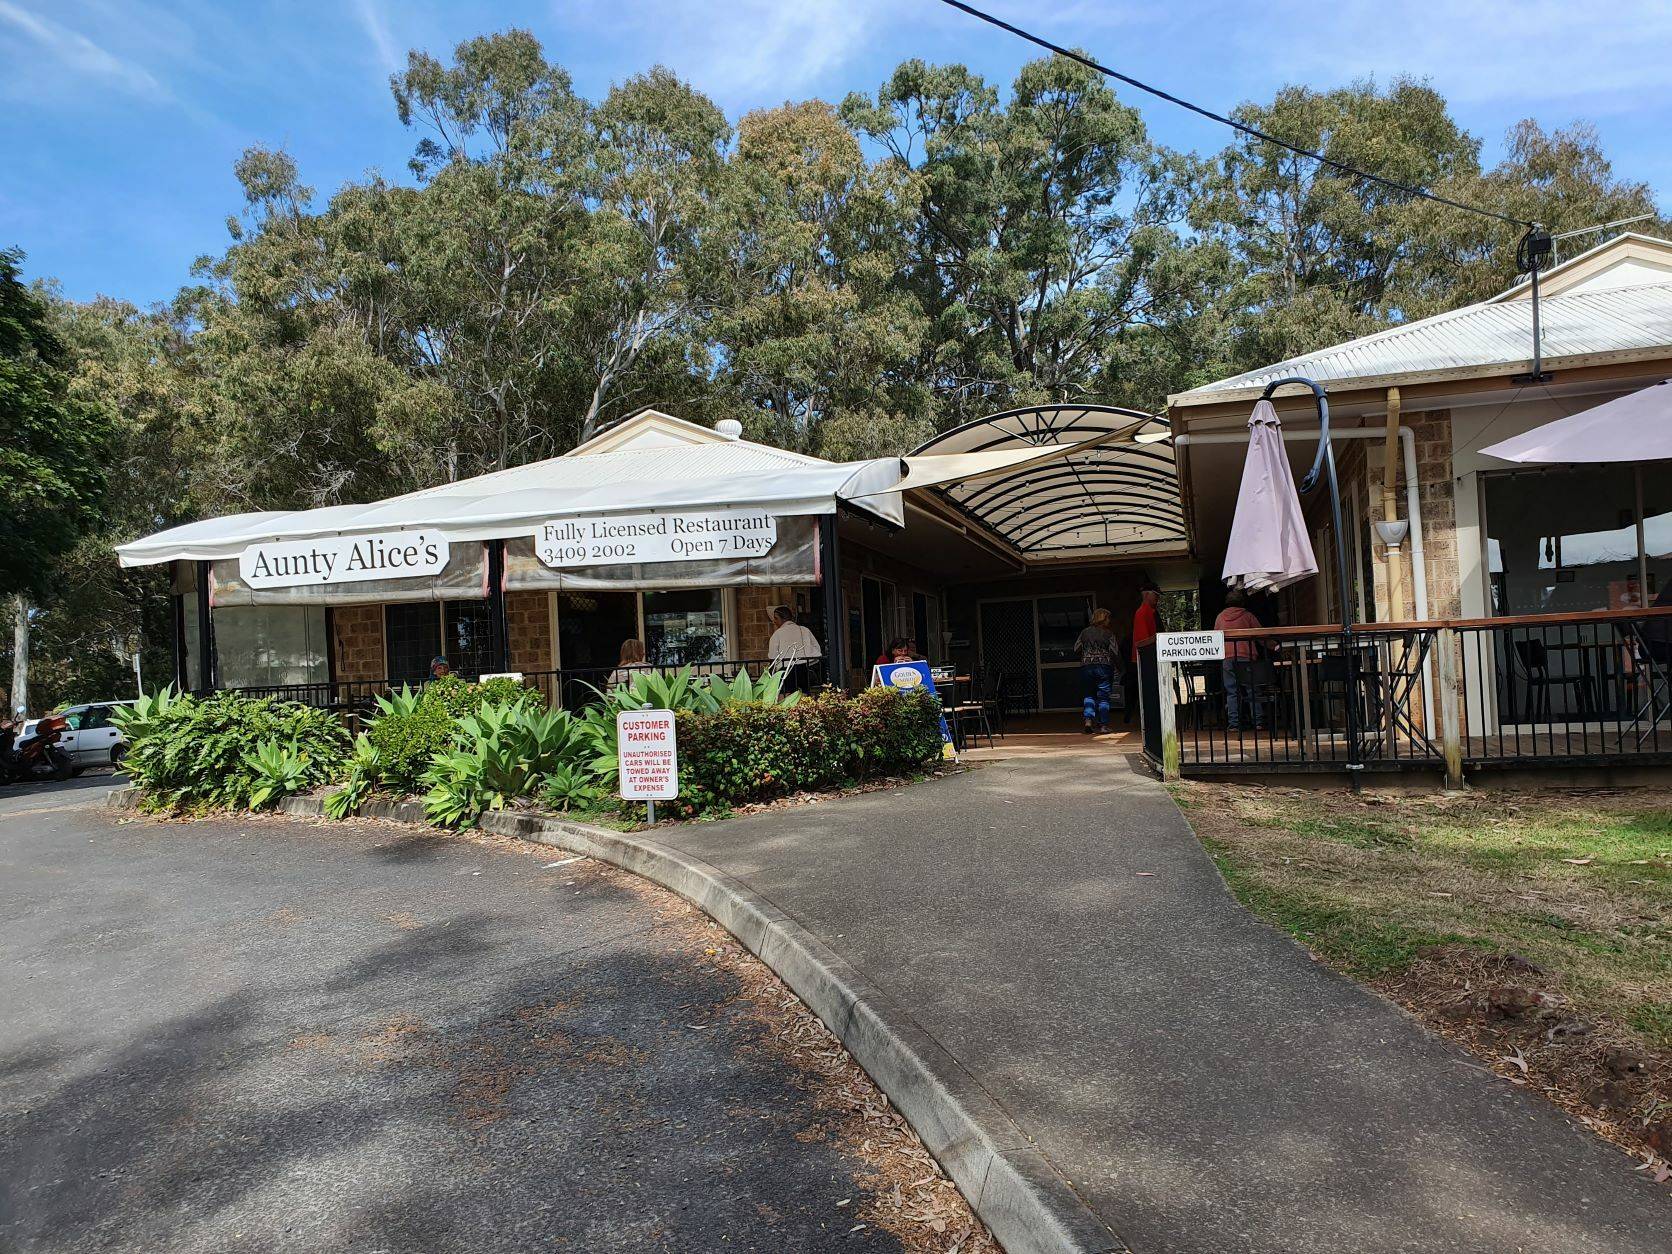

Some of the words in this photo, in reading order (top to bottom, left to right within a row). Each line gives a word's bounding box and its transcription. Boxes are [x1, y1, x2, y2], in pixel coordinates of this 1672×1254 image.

[543, 523, 586, 543] Fully
[591, 518, 667, 540] Licensed
[673, 514, 772, 534] Restaurant
[670, 538, 714, 556] Open
[719, 538, 728, 554] 7
[733, 534, 773, 552] Days
[251, 548, 338, 581] Aunty
[345, 535, 439, 571] Alice's
[544, 546, 586, 564] 3409
[591, 543, 637, 558] 2002
[1167, 635, 1213, 646] CUSTOMER
[1161, 648, 1197, 657] PARKING
[1198, 647, 1220, 656] ONLY
[622, 720, 670, 730] CUSTOMER
[628, 732, 666, 741] PARKING
[623, 750, 672, 758] UNAUTHORISED
